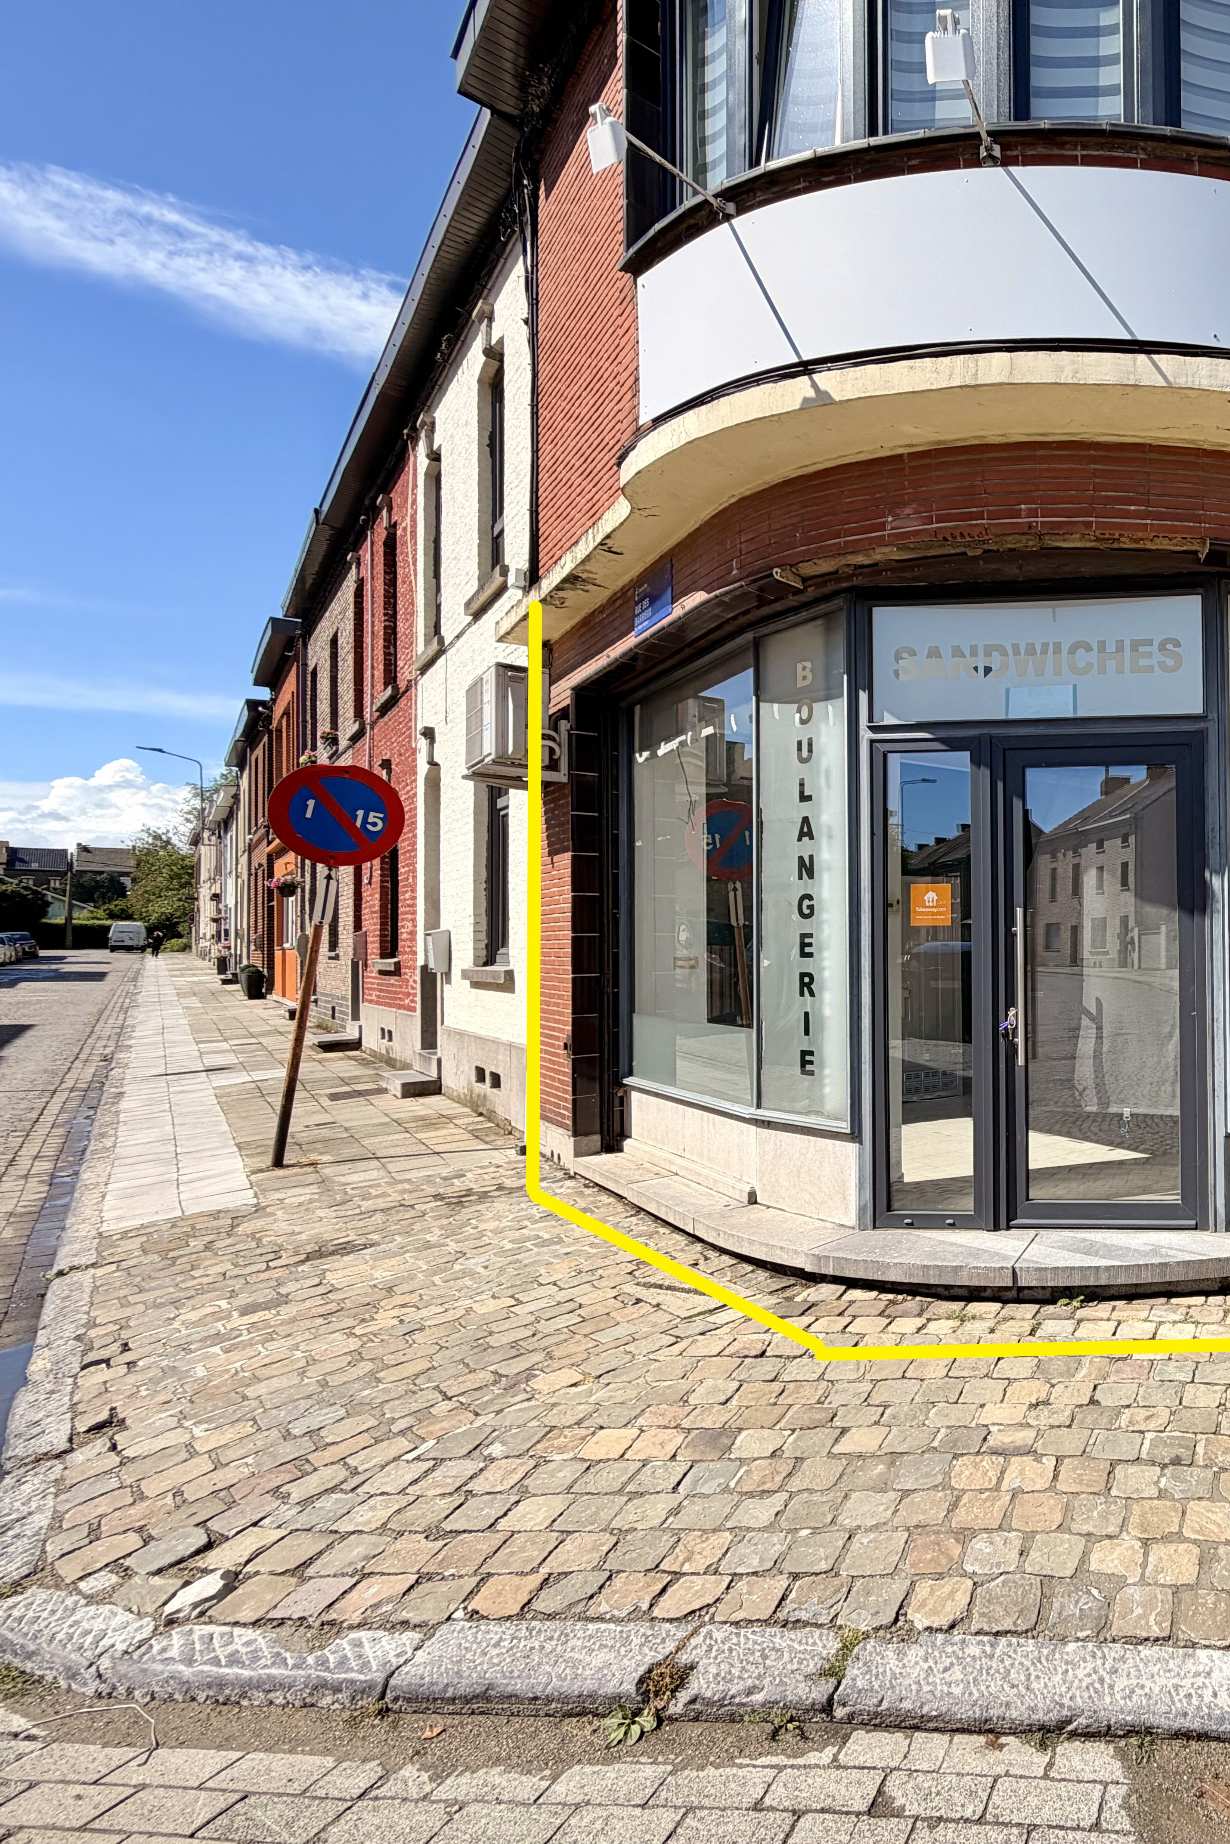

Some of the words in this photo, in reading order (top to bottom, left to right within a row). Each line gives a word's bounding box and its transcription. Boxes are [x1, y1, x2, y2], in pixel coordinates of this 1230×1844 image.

[893, 636, 1184, 681] SANDWICHES
[305, 799, 316, 818] 1
[355, 809, 385, 832] 15
[796, 661, 816, 1077] BOULANGERIE
